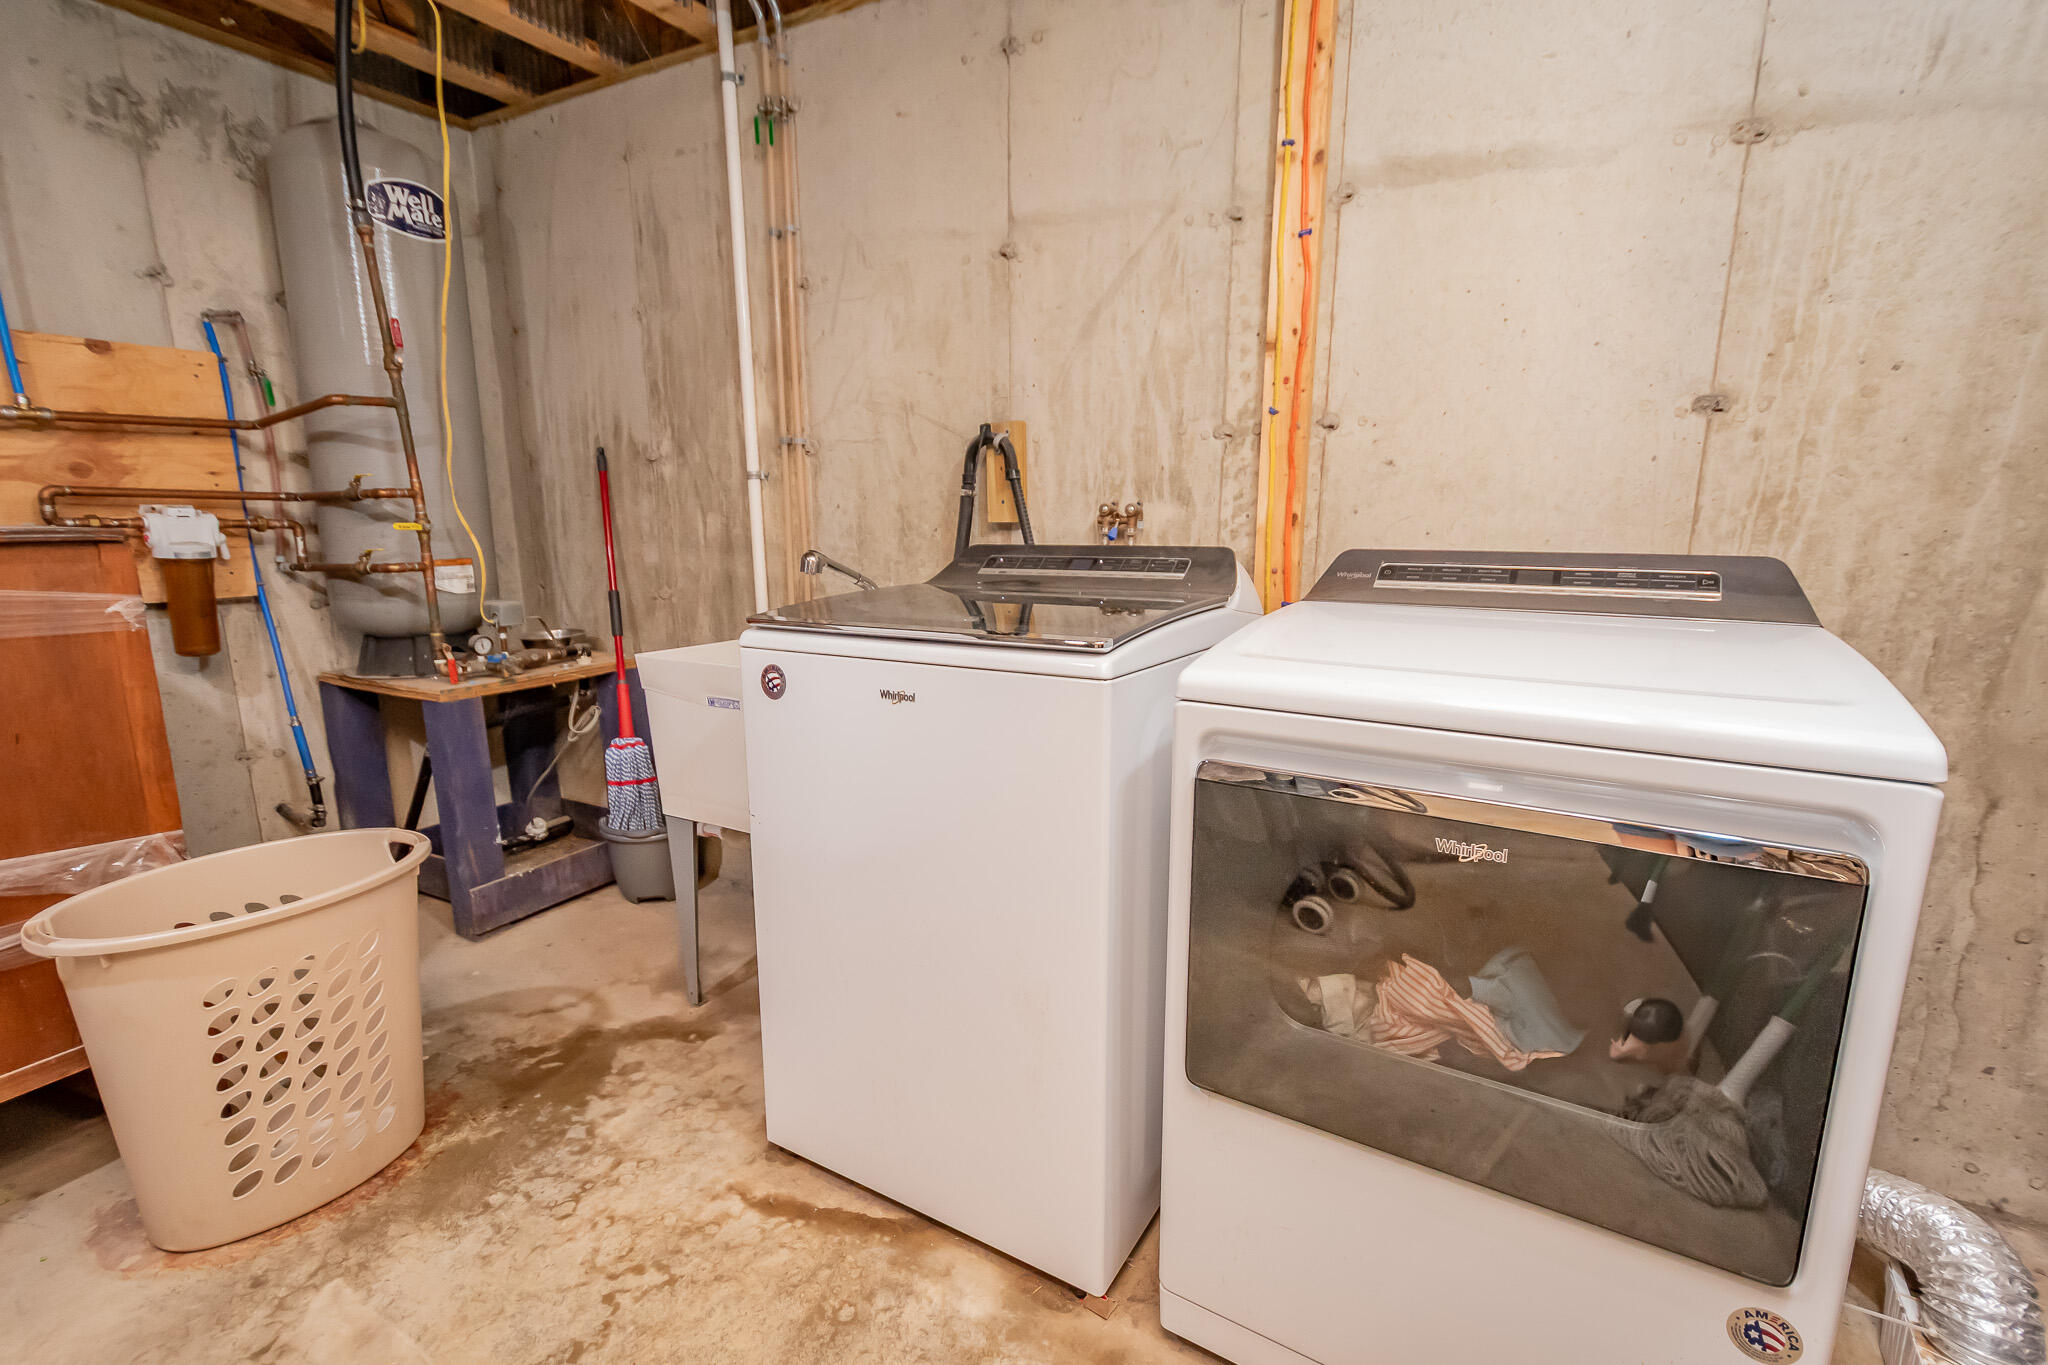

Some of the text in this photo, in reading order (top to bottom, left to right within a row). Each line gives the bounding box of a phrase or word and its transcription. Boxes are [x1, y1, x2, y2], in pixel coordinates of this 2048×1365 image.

[382, 183, 435, 214] Well
[387, 202, 444, 228] Mate
[879, 689, 916, 704] Whirlpool
[1435, 837, 1509, 863] Whirlpool
[1743, 1309, 1800, 1351] AMERICA
